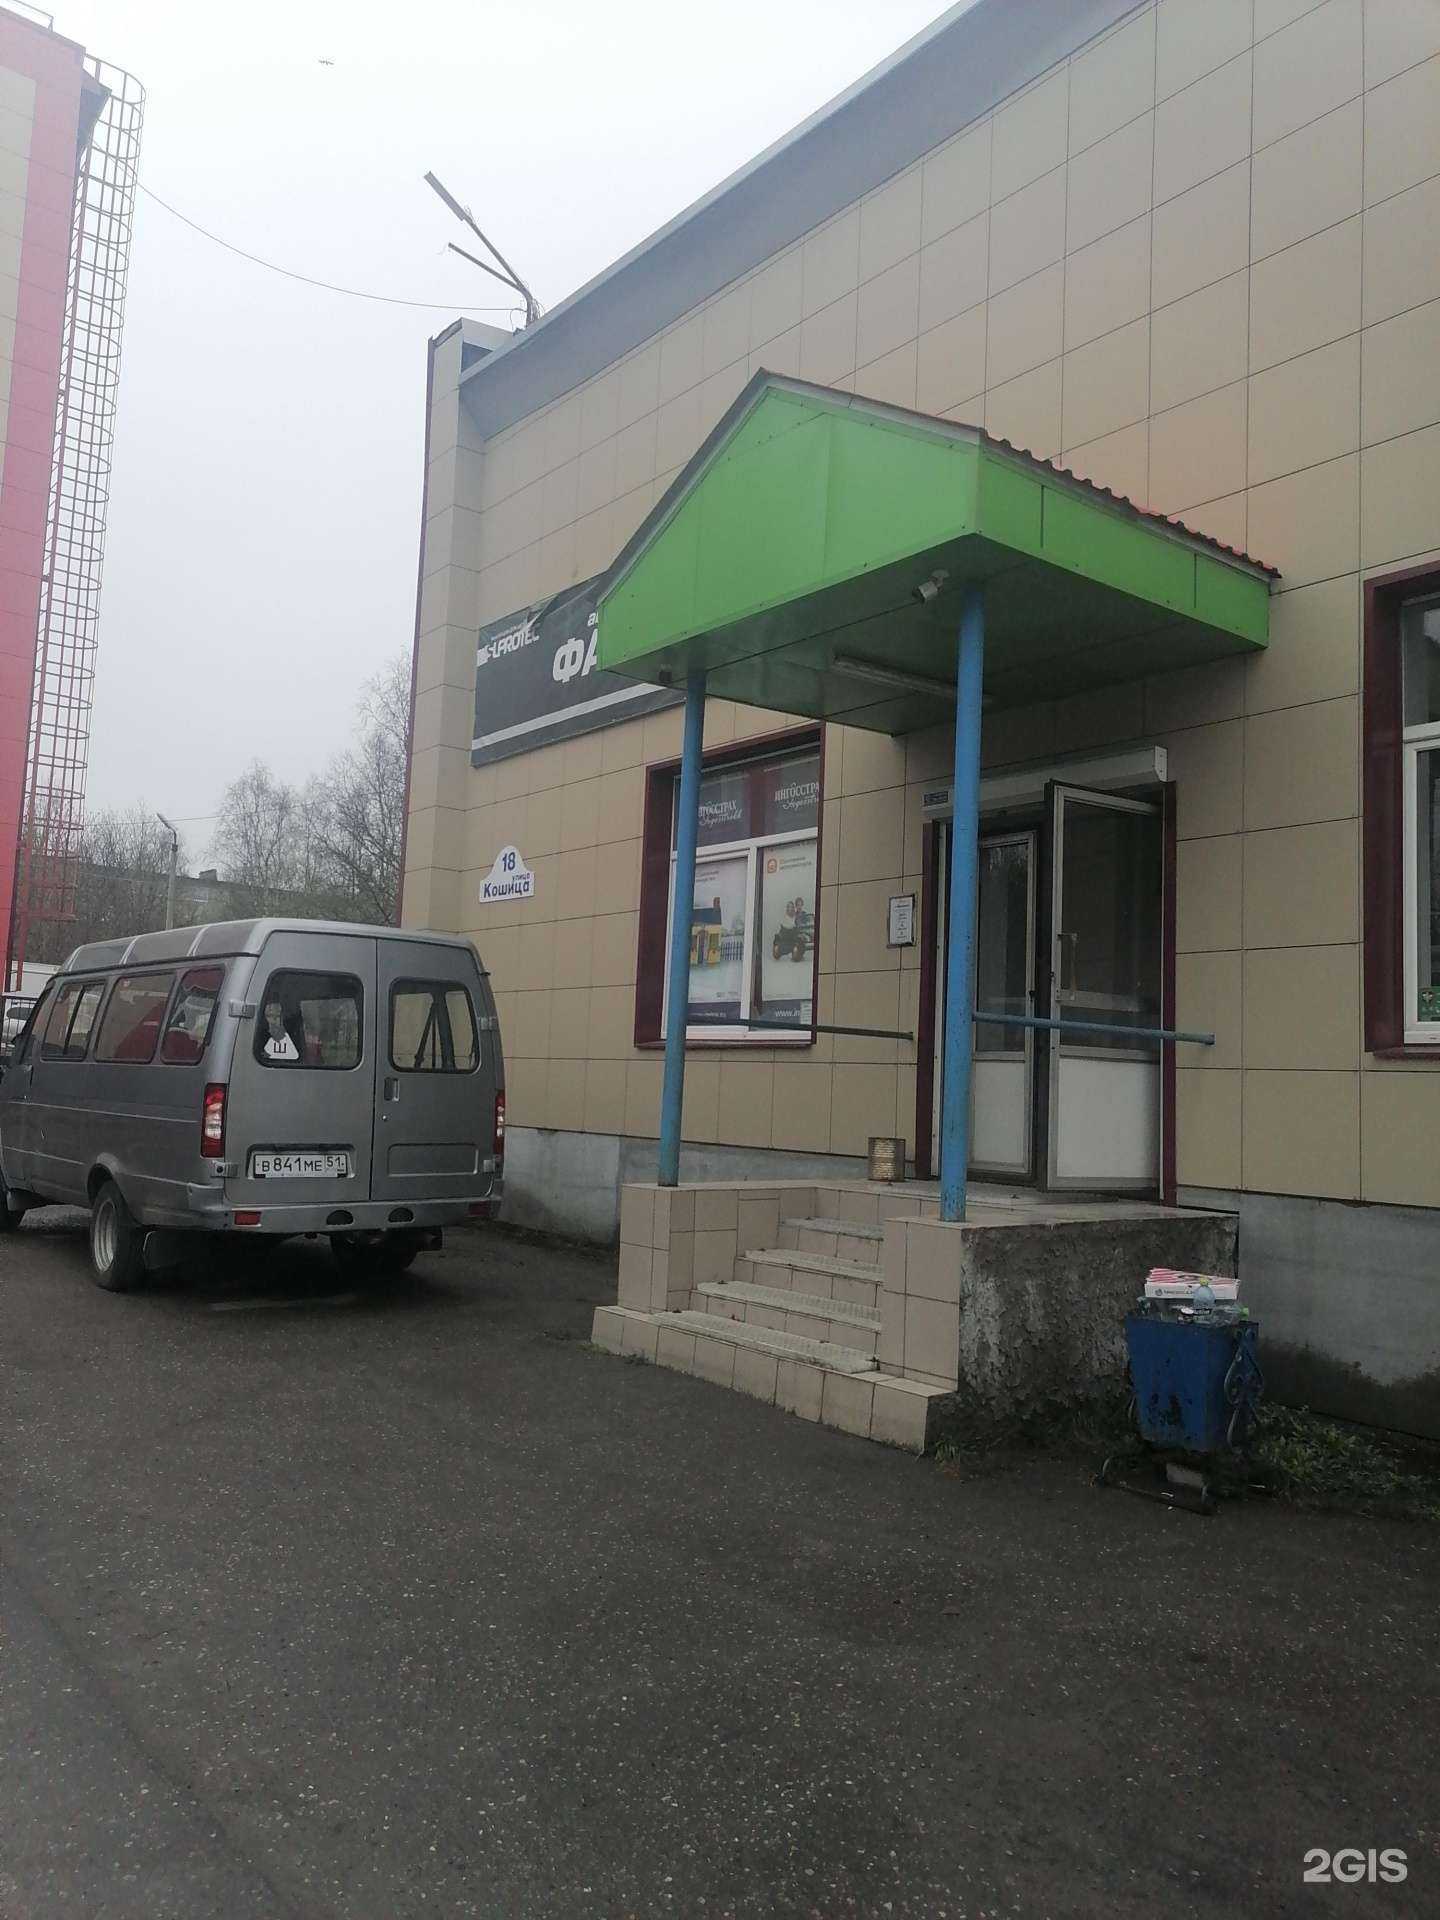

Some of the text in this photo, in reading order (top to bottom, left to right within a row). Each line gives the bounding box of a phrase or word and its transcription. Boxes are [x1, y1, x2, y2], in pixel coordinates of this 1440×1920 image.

[774, 781, 819, 802] ИНГОССТРА
[502, 851, 516, 872] 18
[483, 880, 530, 898] Кошица
[273, 1040, 287, 1054] Ш
